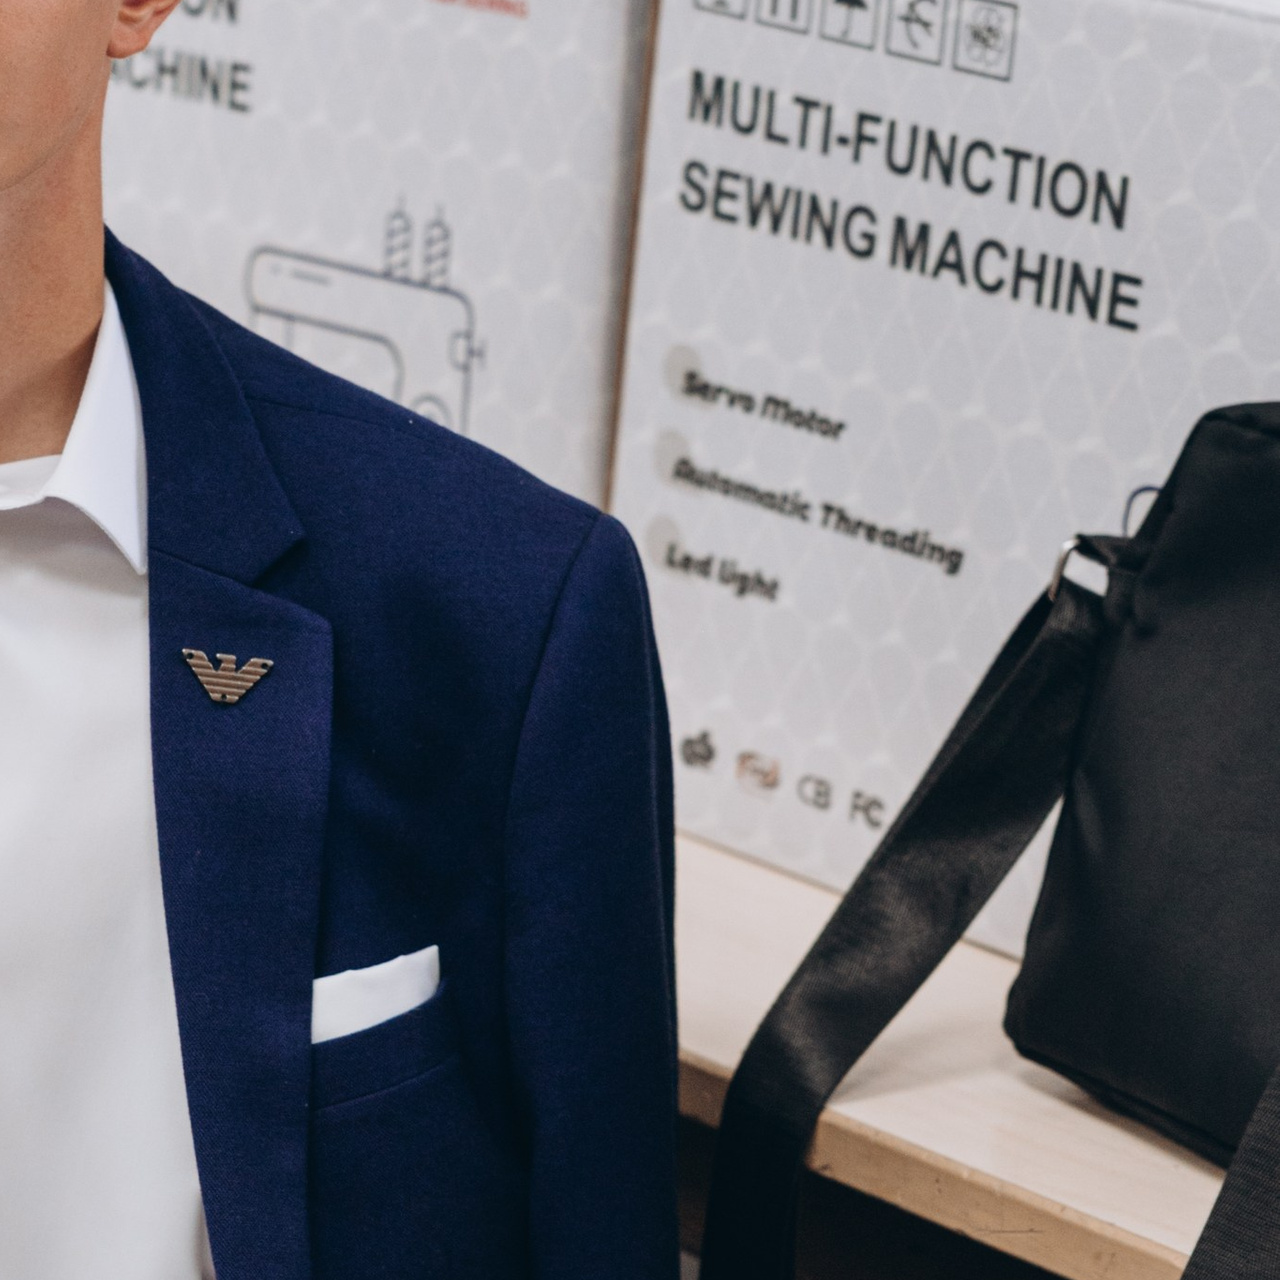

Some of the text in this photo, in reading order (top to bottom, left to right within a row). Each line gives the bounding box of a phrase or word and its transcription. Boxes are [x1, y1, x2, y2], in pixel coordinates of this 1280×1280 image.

[111, 45, 253, 114] CHINE
[687, 69, 1131, 231] MULTI-FUNCTION
[679, 160, 1143, 331] SEWING MACHINE
[682, 370, 846, 441] Servo Motor
[665, 542, 715, 577] Led
[673, 456, 965, 576] Automatic Threading
